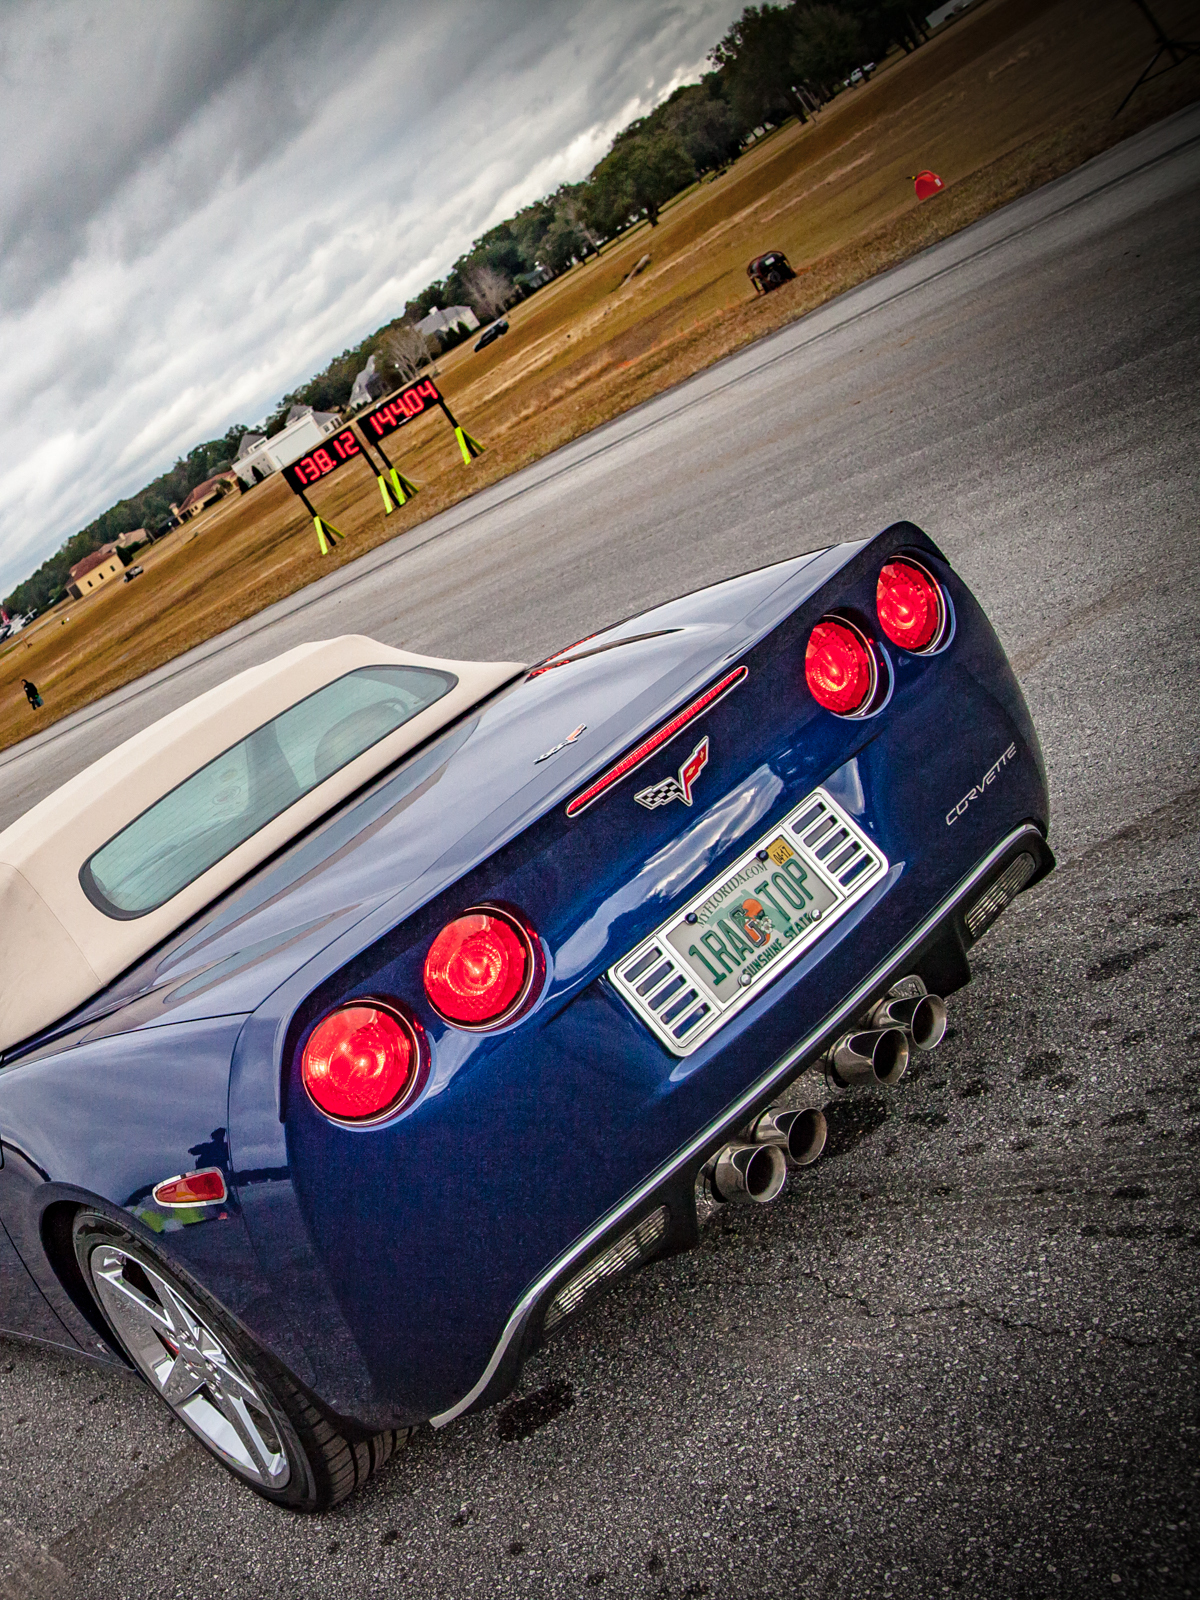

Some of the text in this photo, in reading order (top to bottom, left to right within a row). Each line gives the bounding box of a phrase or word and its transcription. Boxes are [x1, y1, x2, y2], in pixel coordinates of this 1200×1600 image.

[369, 379, 438, 435] 144.04
[294, 431, 360, 484] 138.12
[945, 741, 1017, 826] CORVETTE
[688, 858, 814, 986] 1RAG TOP
[697, 861, 768, 929] MYFLORIDA.COM
[742, 937, 785, 977] SUNSHINE
